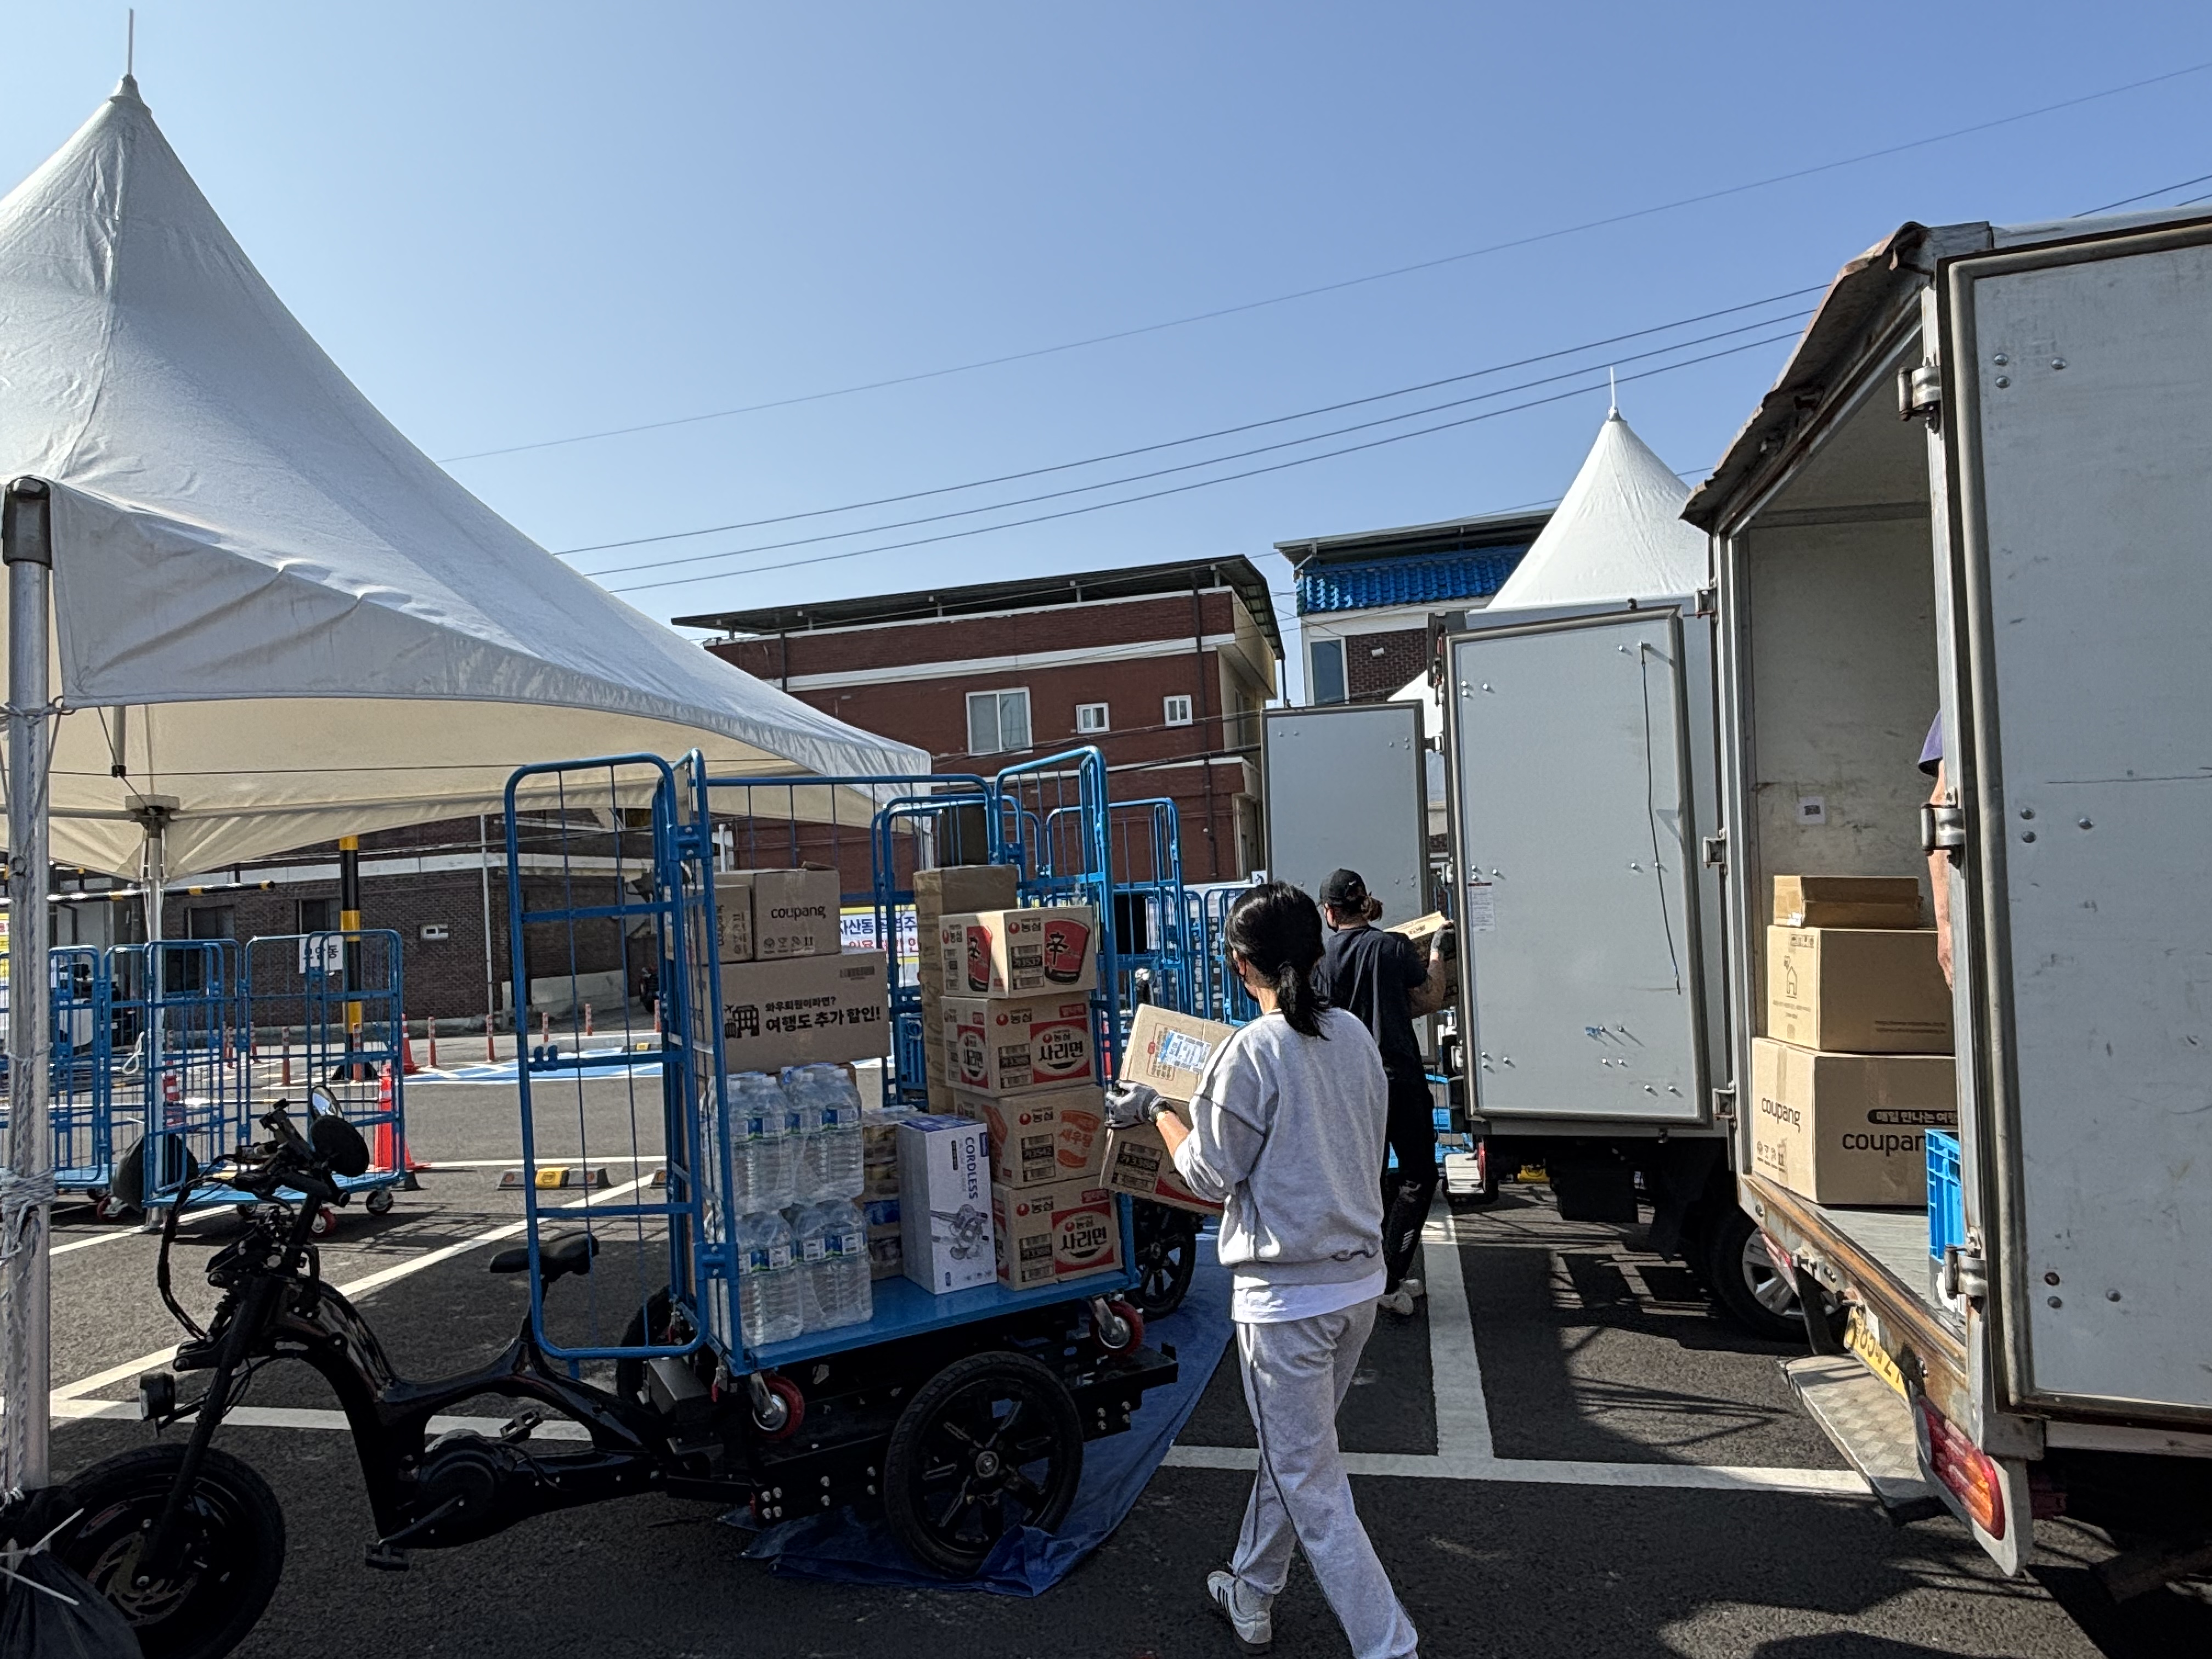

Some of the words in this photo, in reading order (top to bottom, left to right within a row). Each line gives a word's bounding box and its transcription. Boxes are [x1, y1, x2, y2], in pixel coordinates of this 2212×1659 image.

[771, 906, 826, 921] coupang
[1046, 932, 1069, 966] 辛
[766, 1014, 812, 1032] 여행도
[814, 1009, 844, 1028] 추가
[847, 1006, 881, 1024] 할인!
[1038, 1041, 1084, 1062] 사리면
[1762, 1097, 1801, 1133] coupang
[1842, 1133, 1926, 1156] coupan
[966, 1137, 978, 1199] CORDLESS
[1059, 1226, 1107, 1251] 사리면
